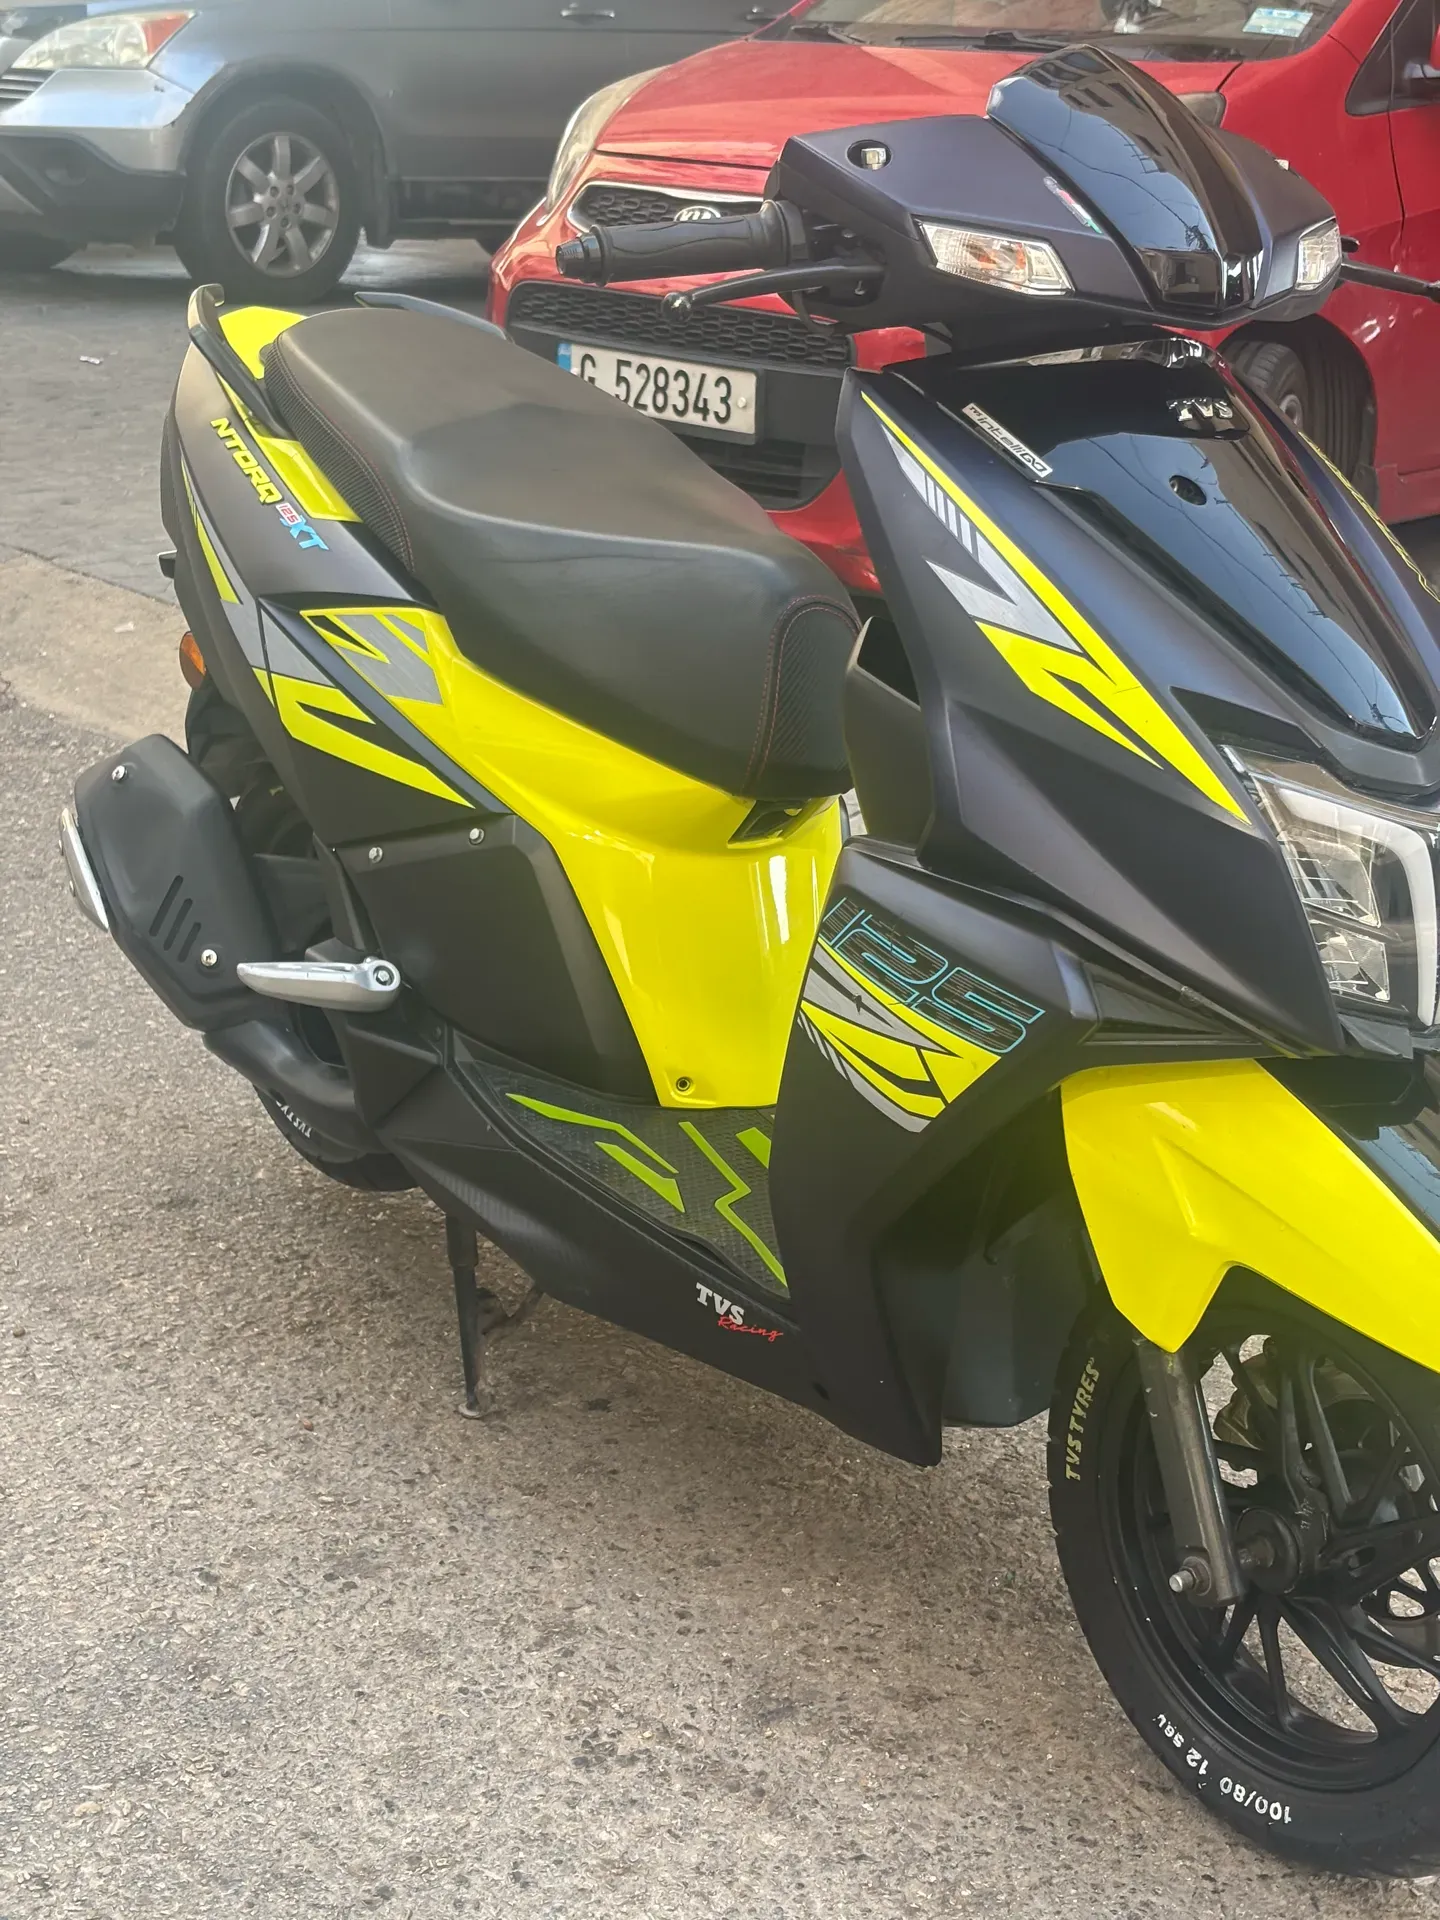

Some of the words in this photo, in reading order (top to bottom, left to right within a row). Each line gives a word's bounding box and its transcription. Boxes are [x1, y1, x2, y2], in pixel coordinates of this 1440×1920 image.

[580, 353, 597, 386] G
[615, 358, 732, 424] 528343
[1166, 398, 1233, 421] TVS
[969, 406, 983, 417] TVS
[210, 417, 284, 504] NTORQ
[278, 503, 299, 524] 125
[280, 515, 330, 551] XT
[818, 897, 1046, 1053] 125
[695, 1282, 745, 1325] TVS
[717, 1316, 784, 1342] Racing
[1069, 1362, 1099, 1434] TYRES
[1065, 1432, 1082, 1481] TVS
[1186, 1747, 1209, 1775] 12
[1219, 1776, 1292, 1824] 100/80
